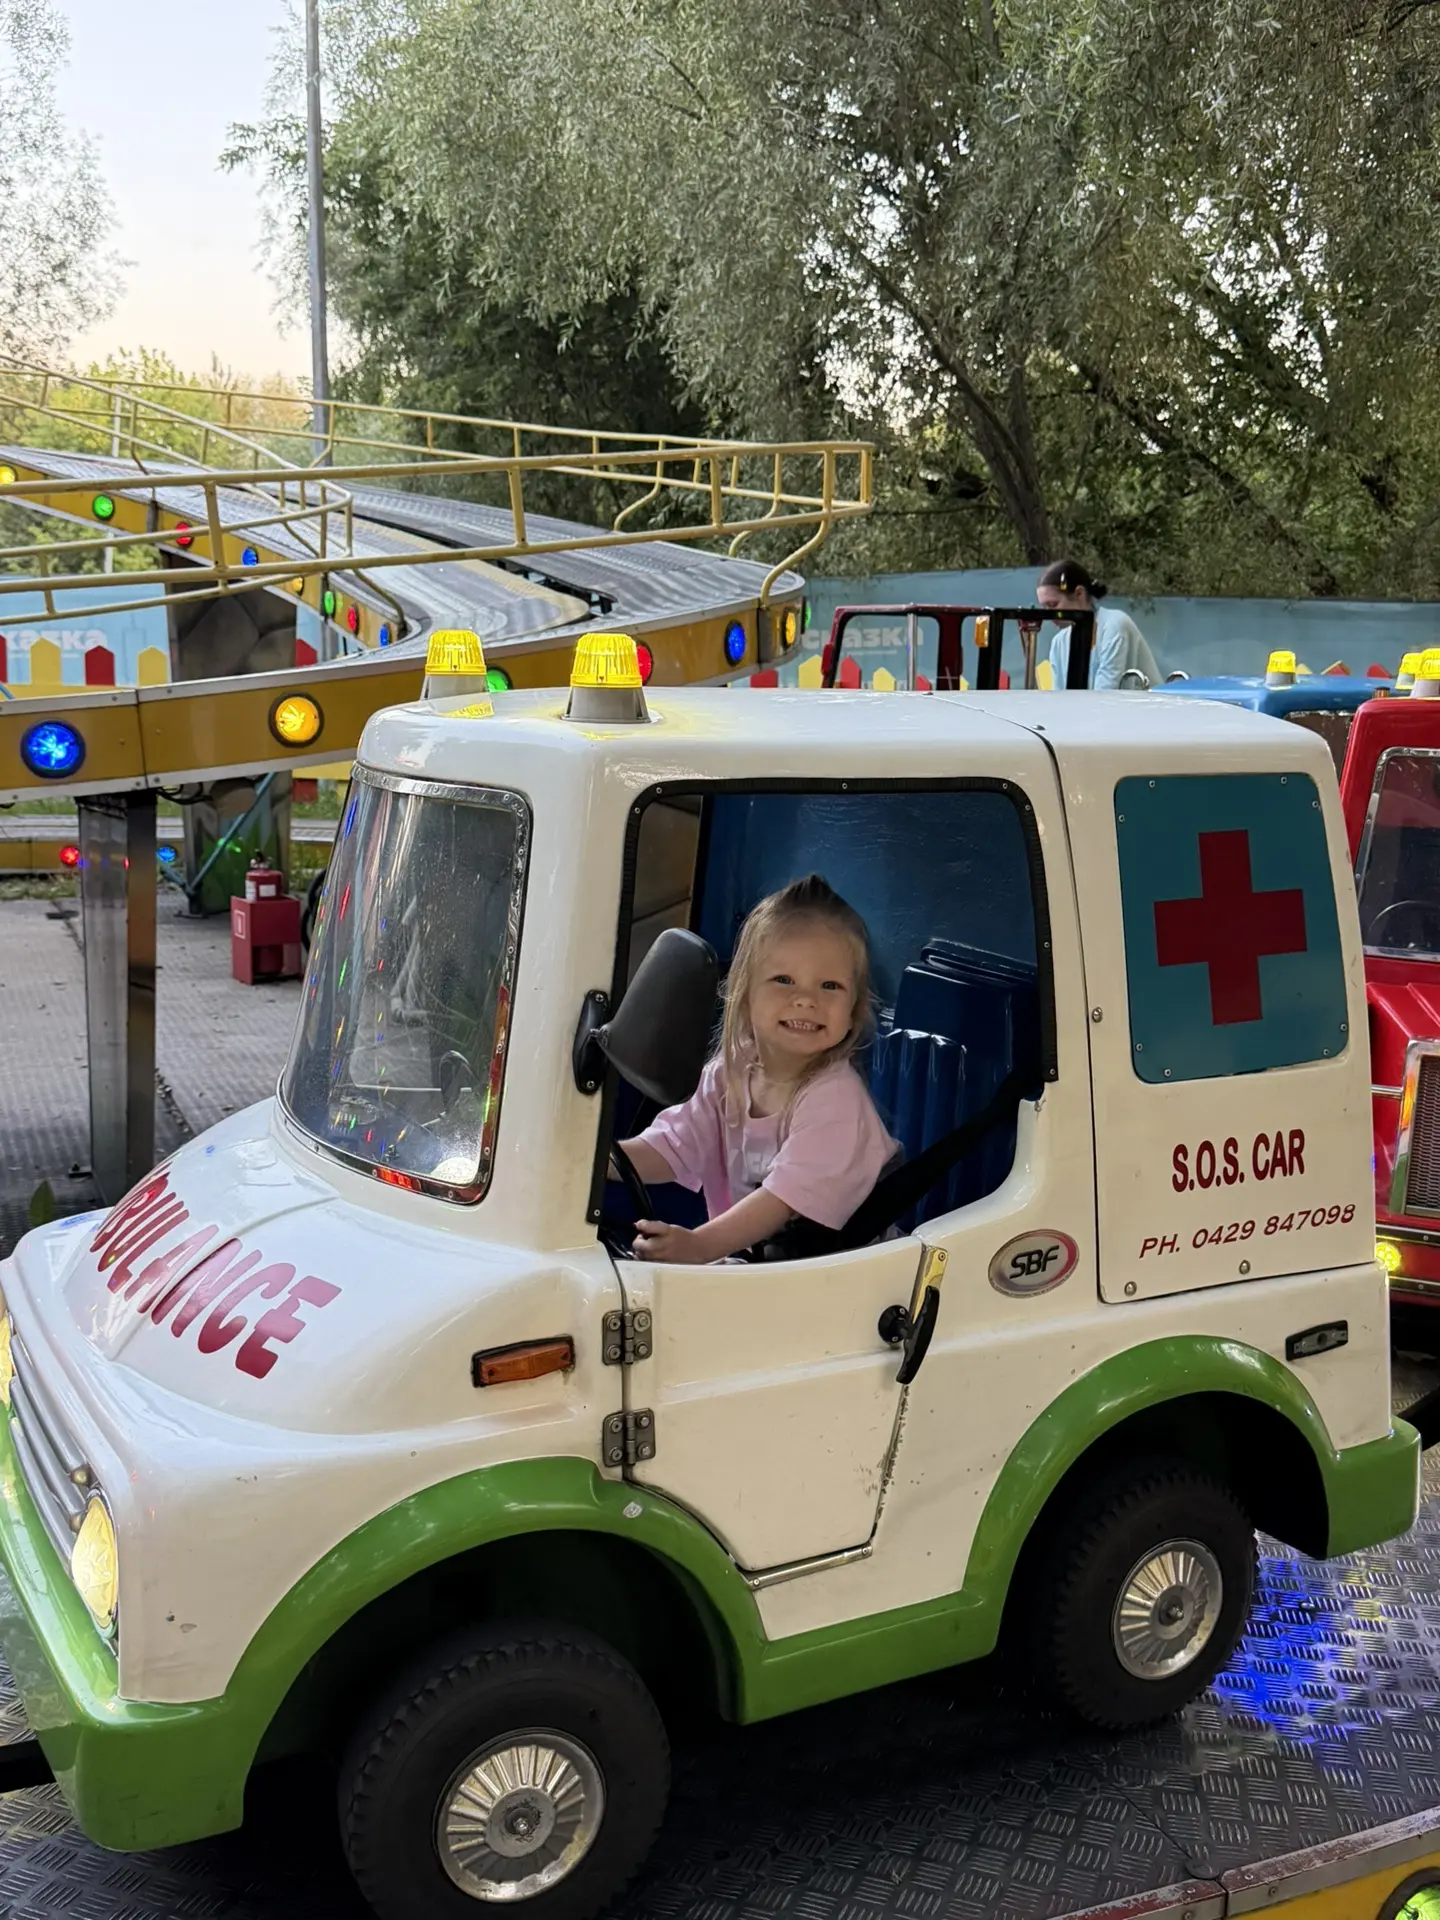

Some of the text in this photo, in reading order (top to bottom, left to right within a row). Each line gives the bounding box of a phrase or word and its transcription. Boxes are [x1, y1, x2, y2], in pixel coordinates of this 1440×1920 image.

[0, 629, 108, 651] кака
[1171, 1128, 1305, 1193] S.O.S. CAR
[1139, 1203, 1356, 1259] PH. 0429 847098
[90, 1160, 343, 1380] BULANCE
[1008, 1244, 1060, 1280] SBF
